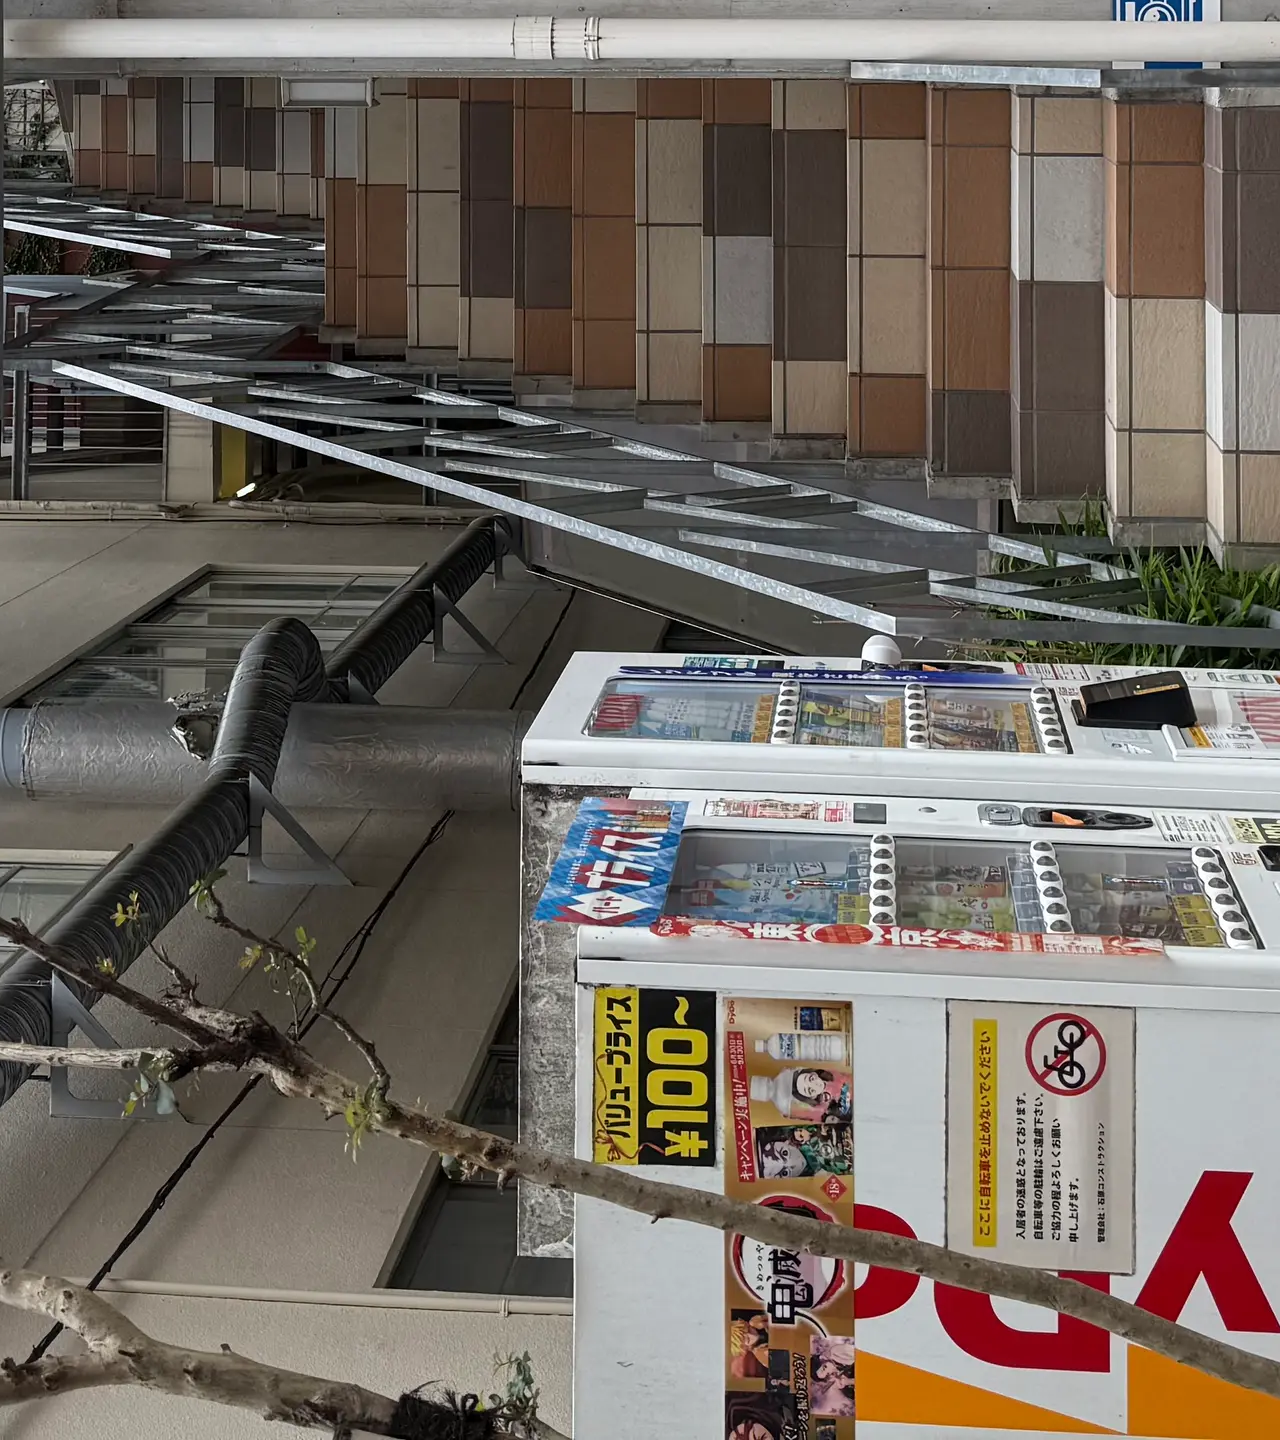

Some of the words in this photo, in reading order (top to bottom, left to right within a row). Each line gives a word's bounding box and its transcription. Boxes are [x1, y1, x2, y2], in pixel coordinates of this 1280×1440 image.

[605, 996, 632, 1138] バリュープライス
[728, 1000, 737, 1024] DyDo
[732, 1078, 753, 1181] キャンペーン実施中!
[978, 1030, 992, 1237] ここに自転車を止めないでください
[1015, 1091, 1027, 1240] 入居者の迷惑となっております。
[1033, 1092, 1045, 1240] 自転車等の駐輪はご遠慮下さい。
[1051, 1118, 1062, 1241] ご協力の程よろしくお願い
[1068, 1177, 1080, 1243] 申し上げます。
